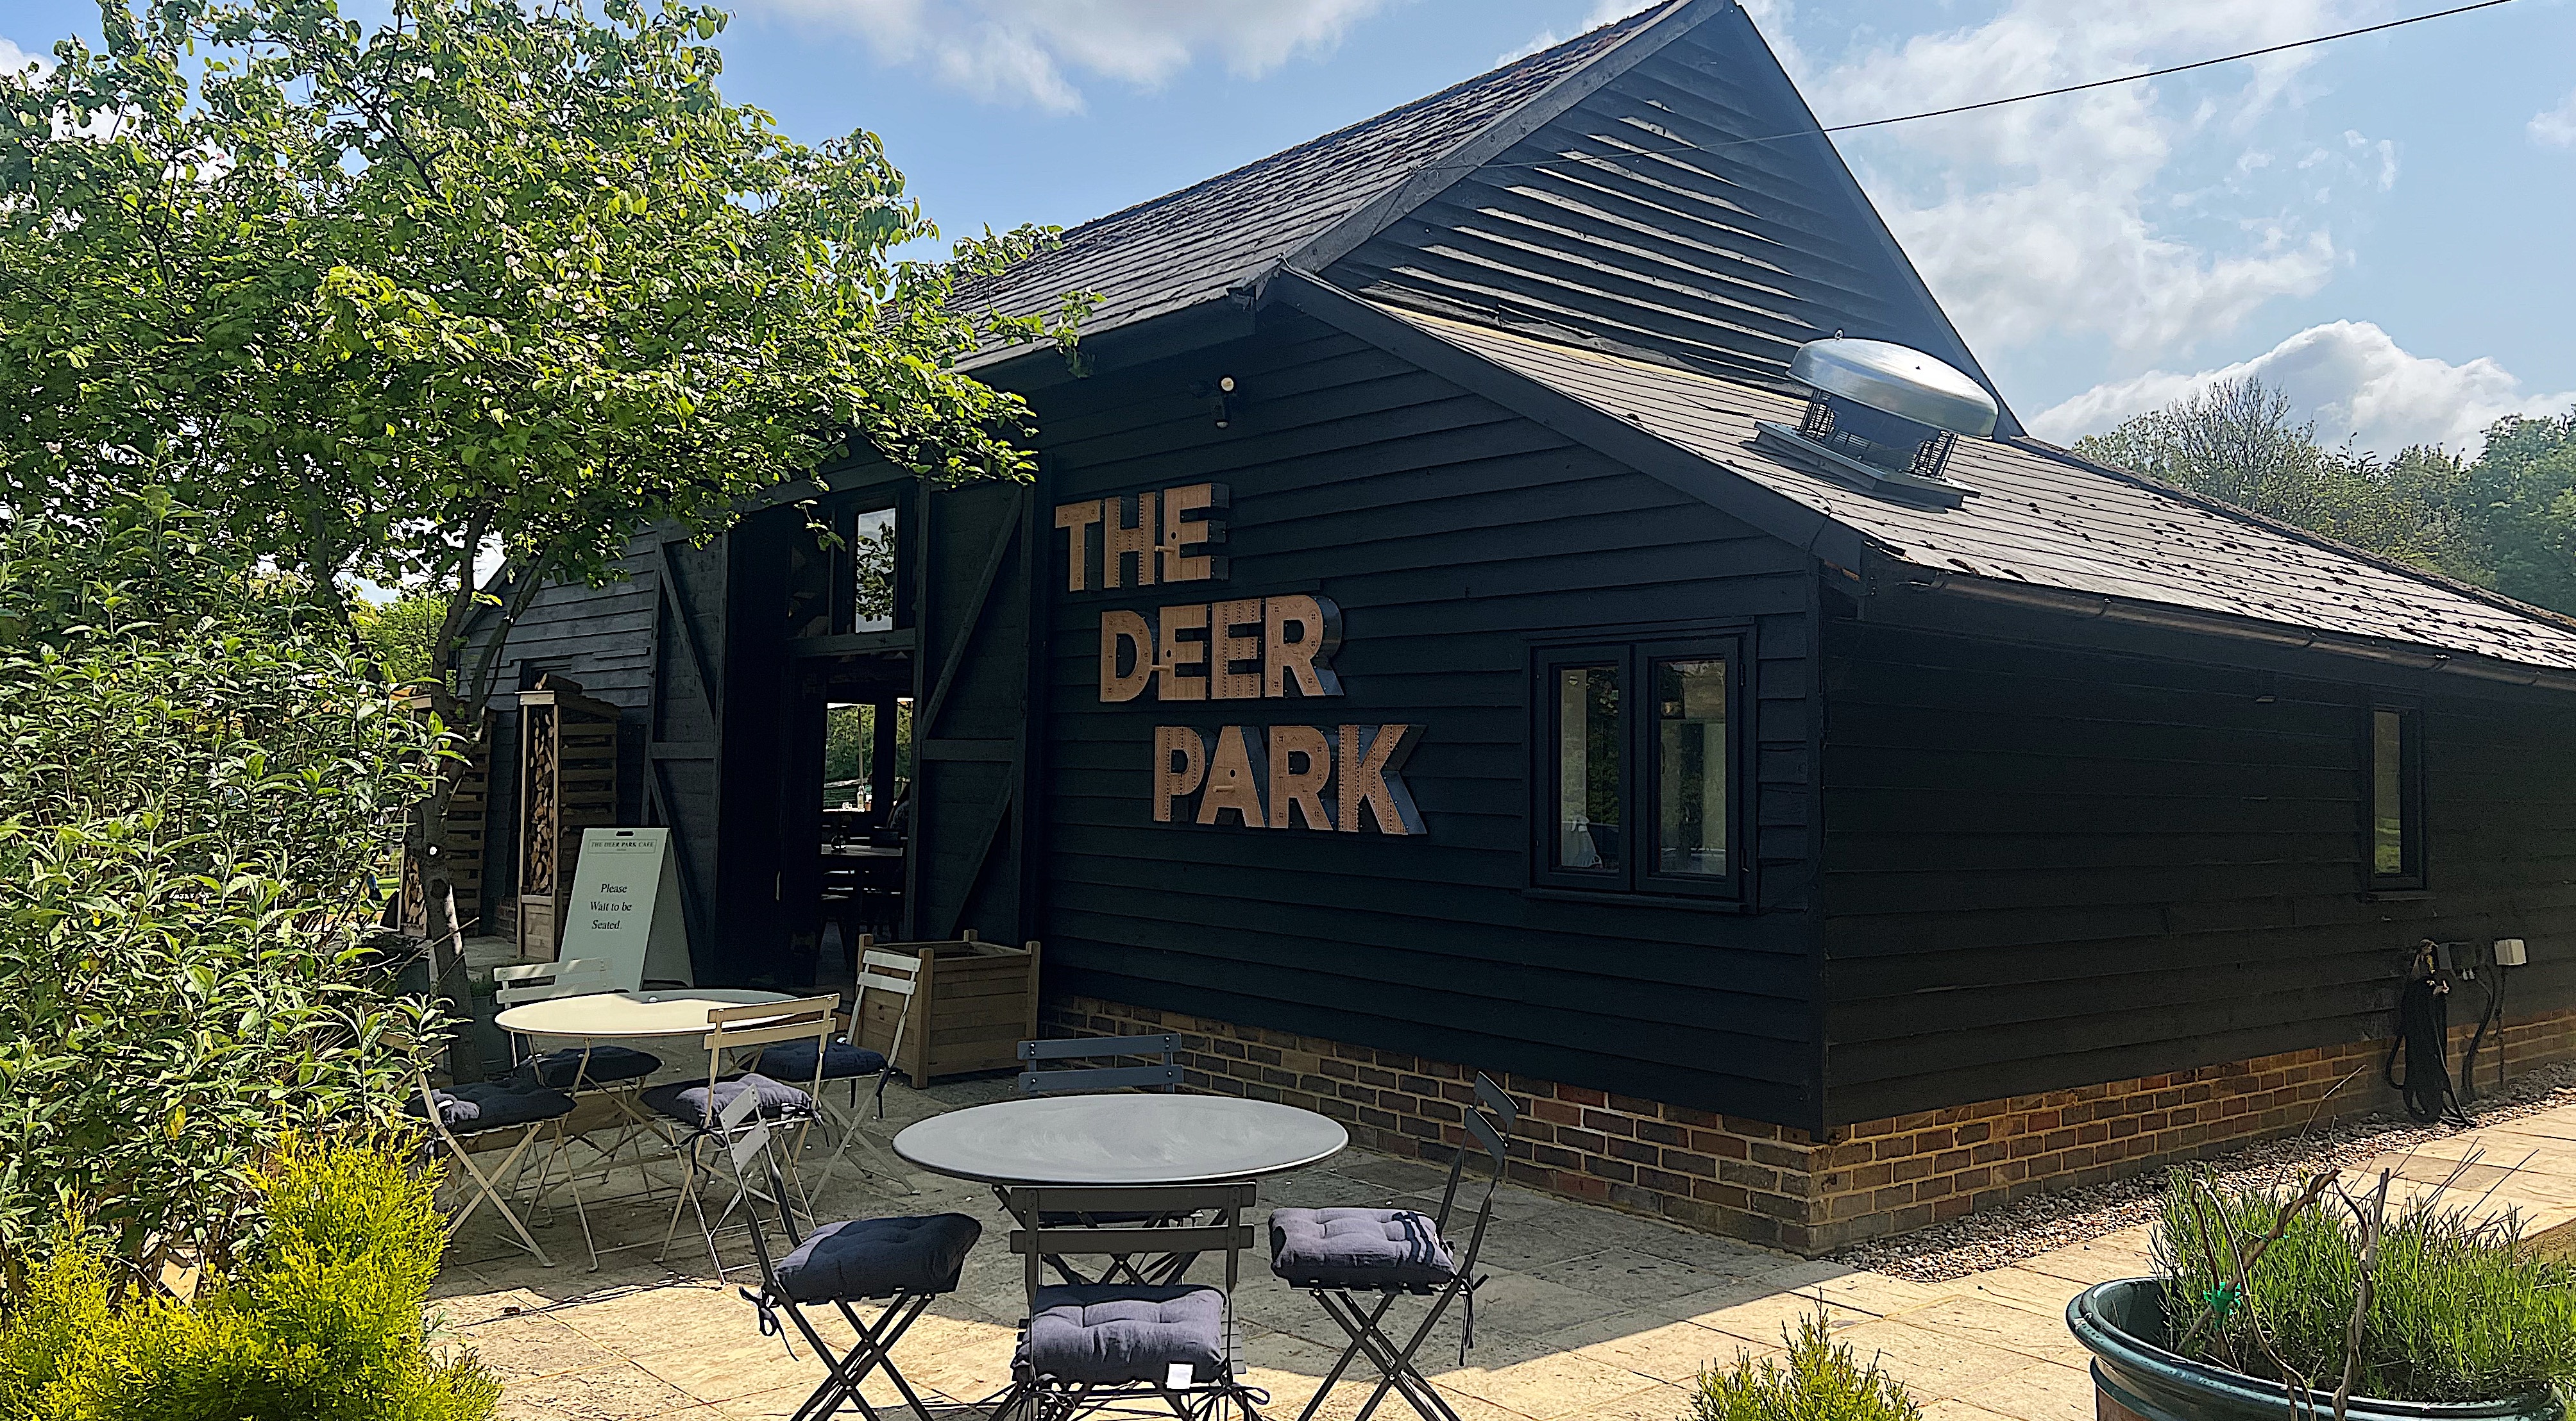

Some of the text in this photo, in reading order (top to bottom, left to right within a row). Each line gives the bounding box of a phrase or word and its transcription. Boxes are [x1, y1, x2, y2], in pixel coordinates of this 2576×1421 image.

[1055, 482, 1214, 592] THE
[1099, 594, 1328, 702] DEER
[1154, 724, 1410, 835] PARK
[590, 901, 632, 911] Wait to be
[600, 883, 627, 893] Please
